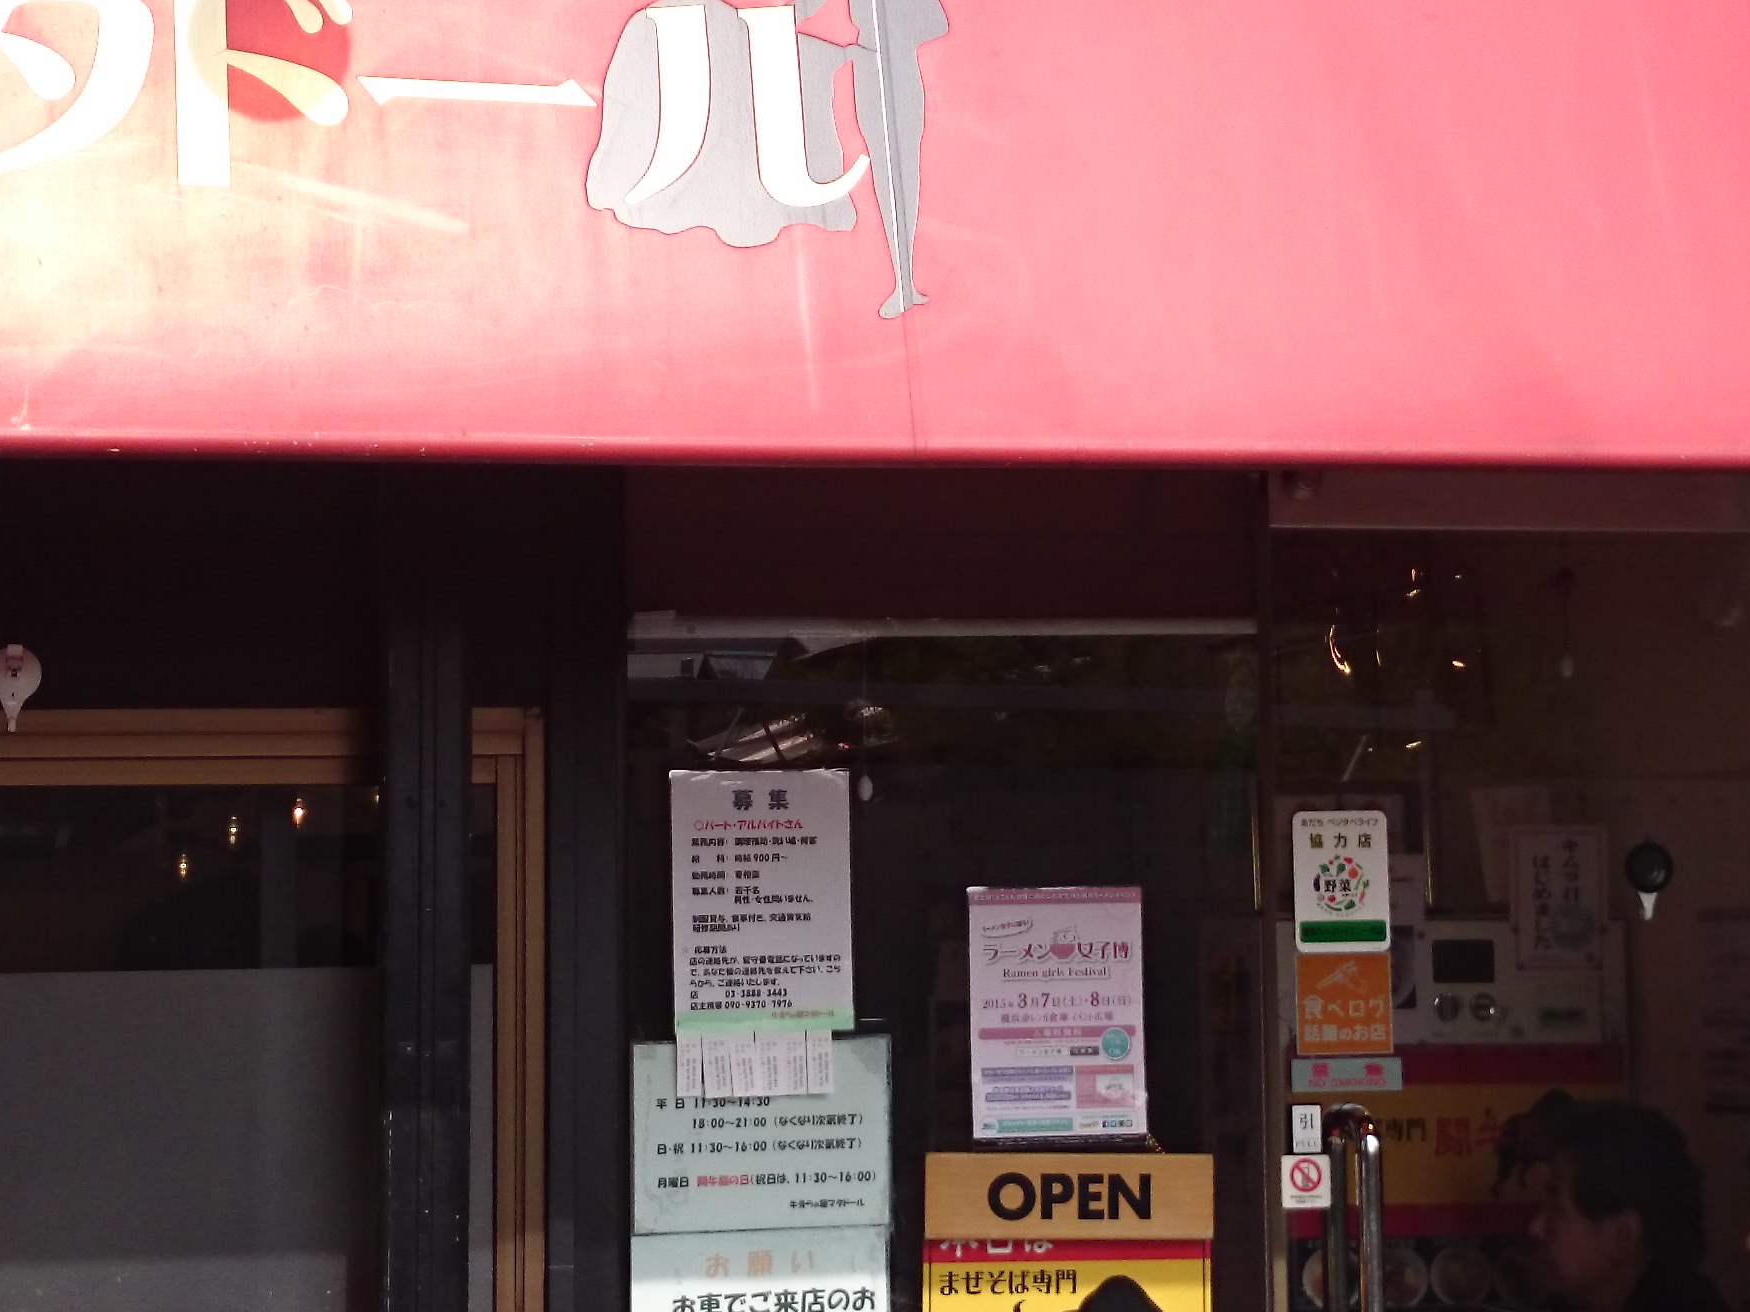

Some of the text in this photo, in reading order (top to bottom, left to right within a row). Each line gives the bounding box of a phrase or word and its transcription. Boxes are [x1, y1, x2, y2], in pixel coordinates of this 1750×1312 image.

[732, 788, 789, 811] 募集
[1309, 832, 1372, 849] 協力店
[1324, 878, 1352, 893] 野菜
[1003, 967, 1038, 978] Ramen
[1068, 965, 1107, 977] Festival
[1303, 994, 1385, 1020] 食べログ
[1299, 1113, 1314, 1130] 引
[987, 1171, 1151, 1221] OPEN
[705, 1249, 815, 1278] お願い
[938, 1268, 1077, 1295] まぜそば専門
